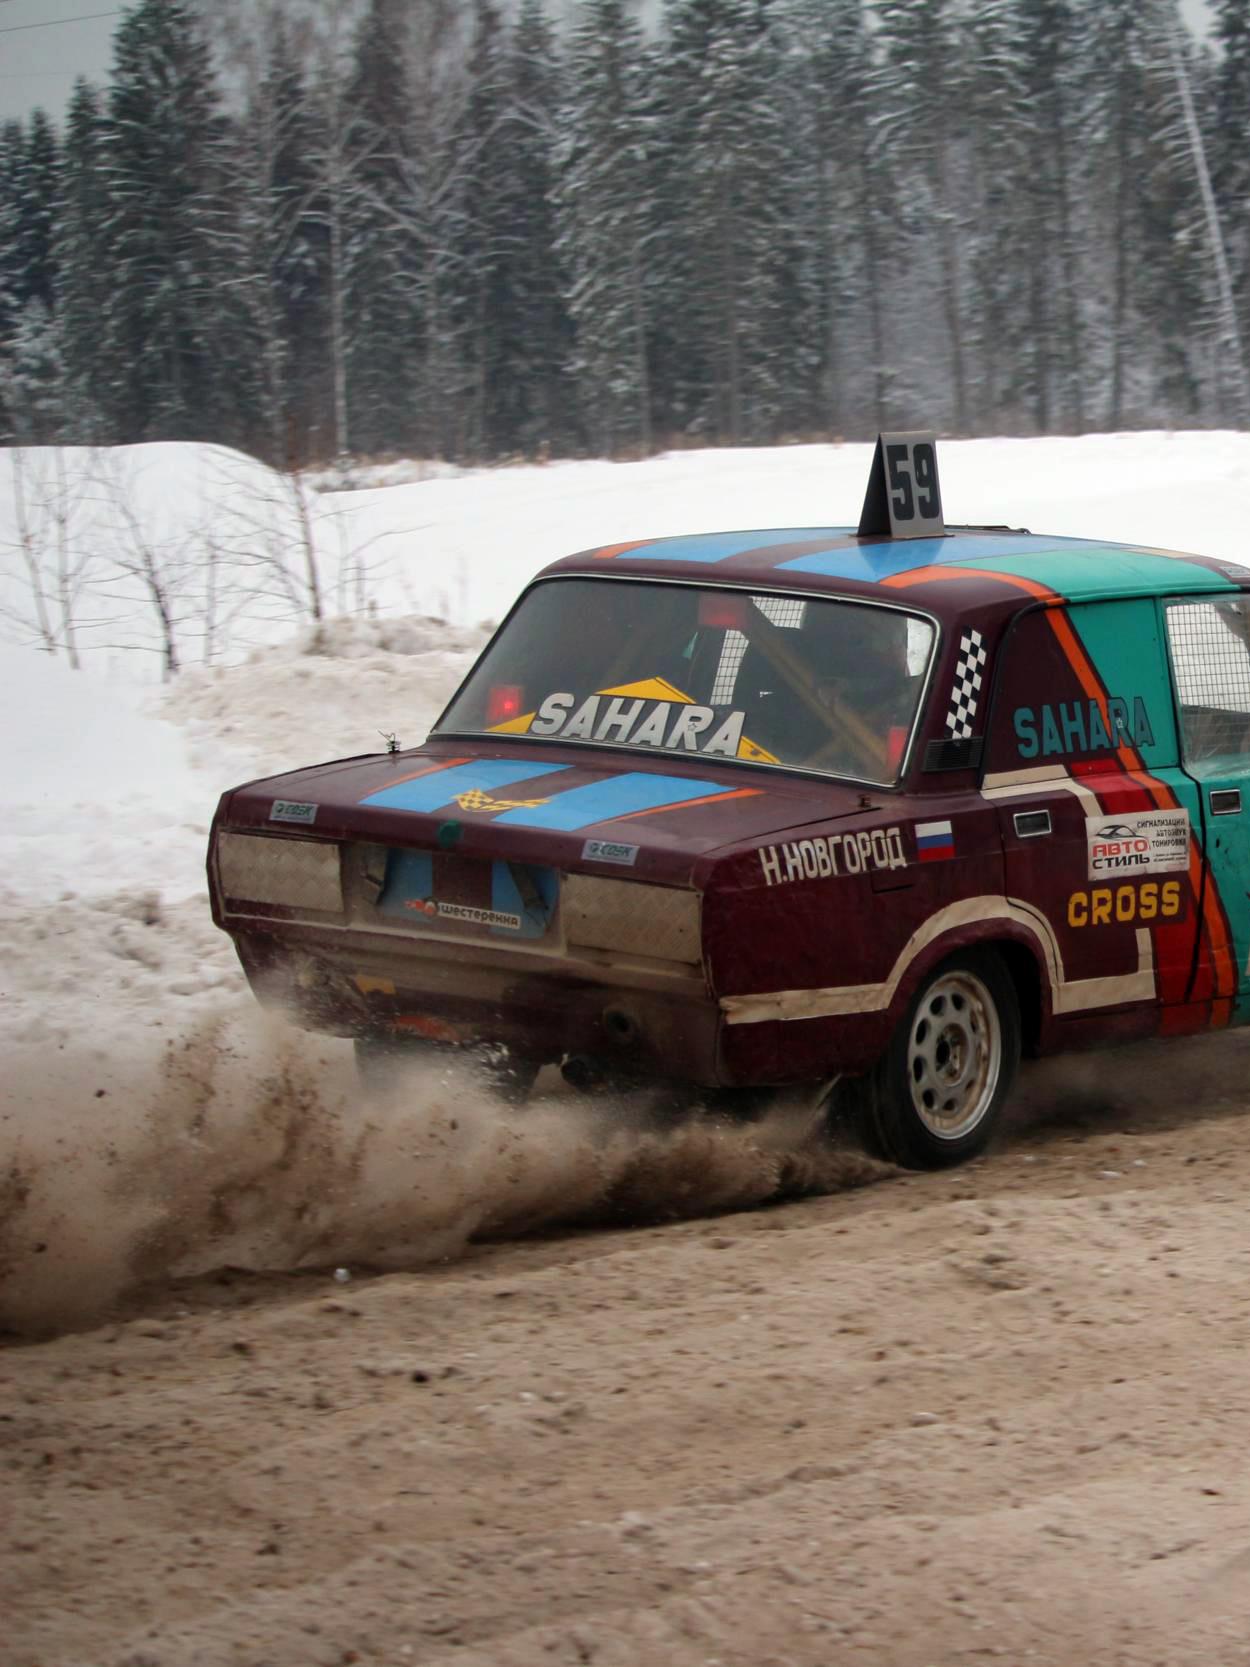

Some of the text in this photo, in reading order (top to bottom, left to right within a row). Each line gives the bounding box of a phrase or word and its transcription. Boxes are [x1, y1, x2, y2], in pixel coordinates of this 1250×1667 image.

[886, 443, 940, 521] 59
[530, 692, 745, 757] SAHARA
[1013, 696, 1155, 759] SAHARA
[759, 827, 907, 886] Н.НОВГОРОД
[1092, 839, 1149, 858] АВТО
[1092, 853, 1150, 870] СТИЛЬ
[1068, 881, 1180, 928] CROSS
